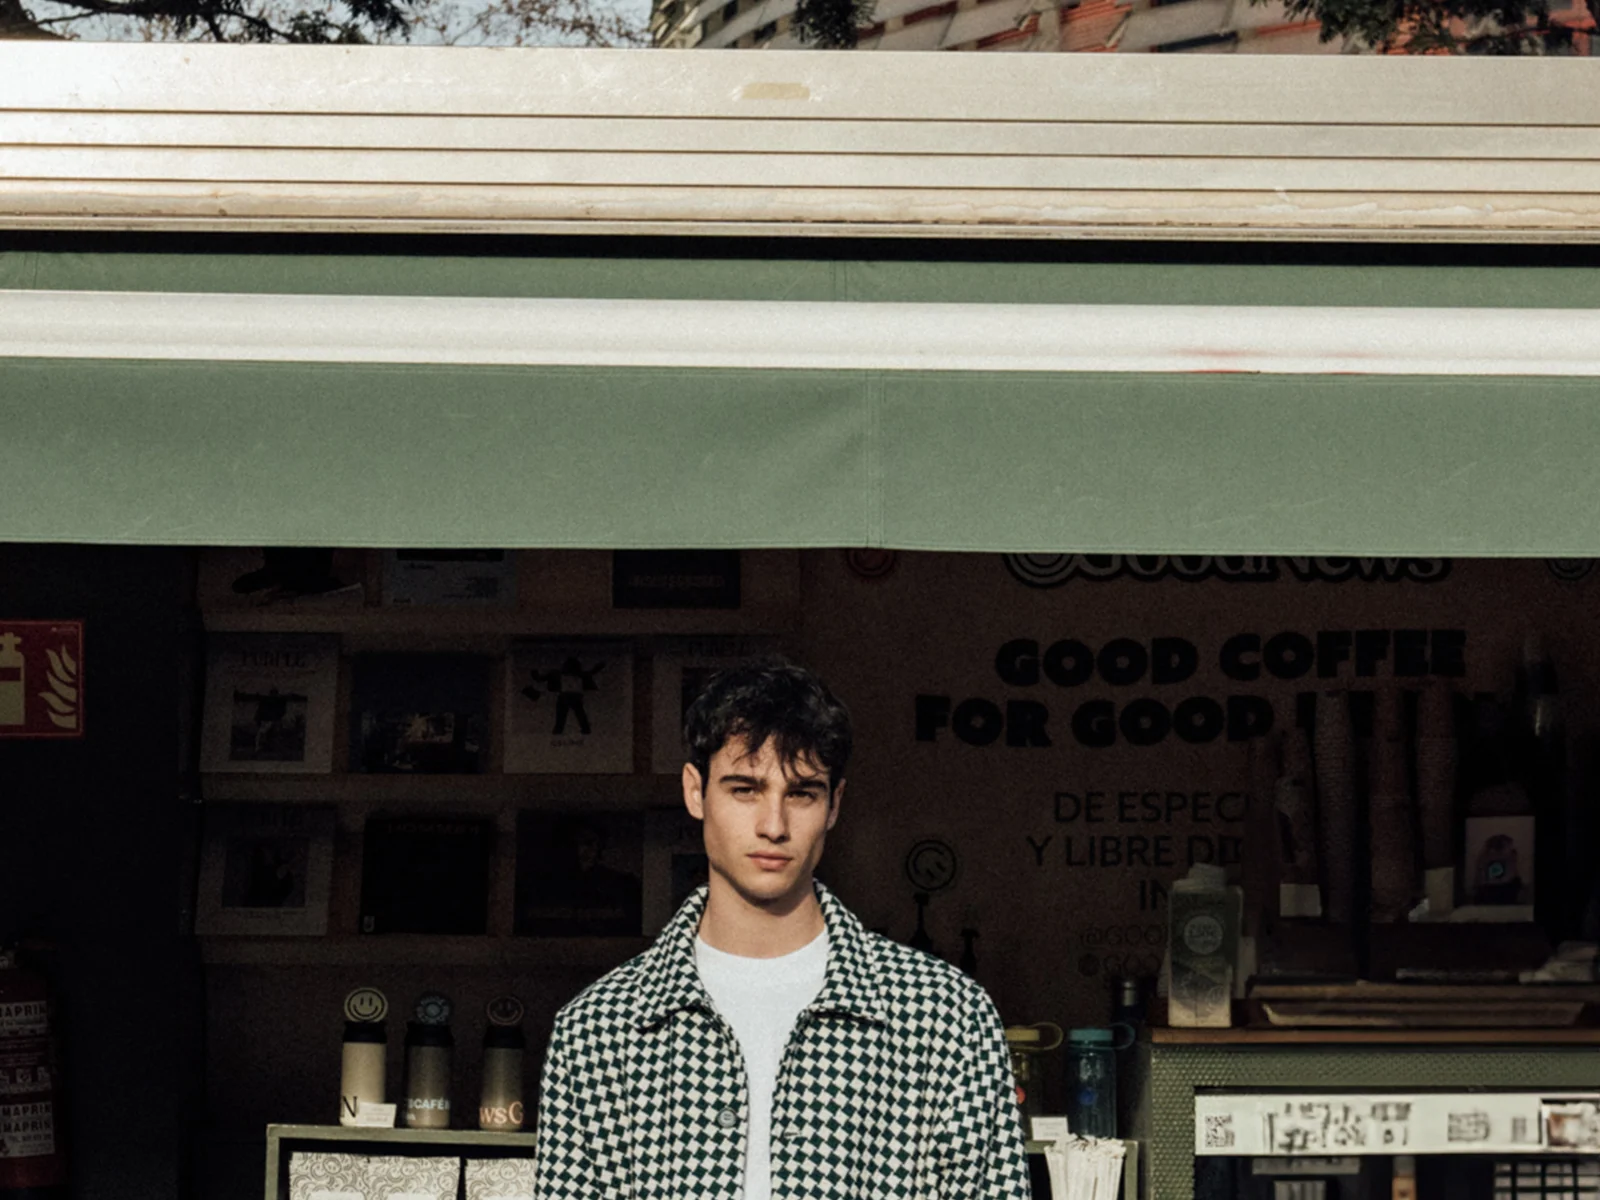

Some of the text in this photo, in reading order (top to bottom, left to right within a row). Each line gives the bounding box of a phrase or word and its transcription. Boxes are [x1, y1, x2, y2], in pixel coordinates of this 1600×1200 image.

[994, 630, 1467, 687] GOOD COFFEE
[914, 695, 1053, 748] FOR
[1071, 695, 1275, 748] GOOD
[1055, 791, 1104, 823] DE
[1026, 835, 1052, 867] Y
[1065, 835, 1174, 867] LIBRE
